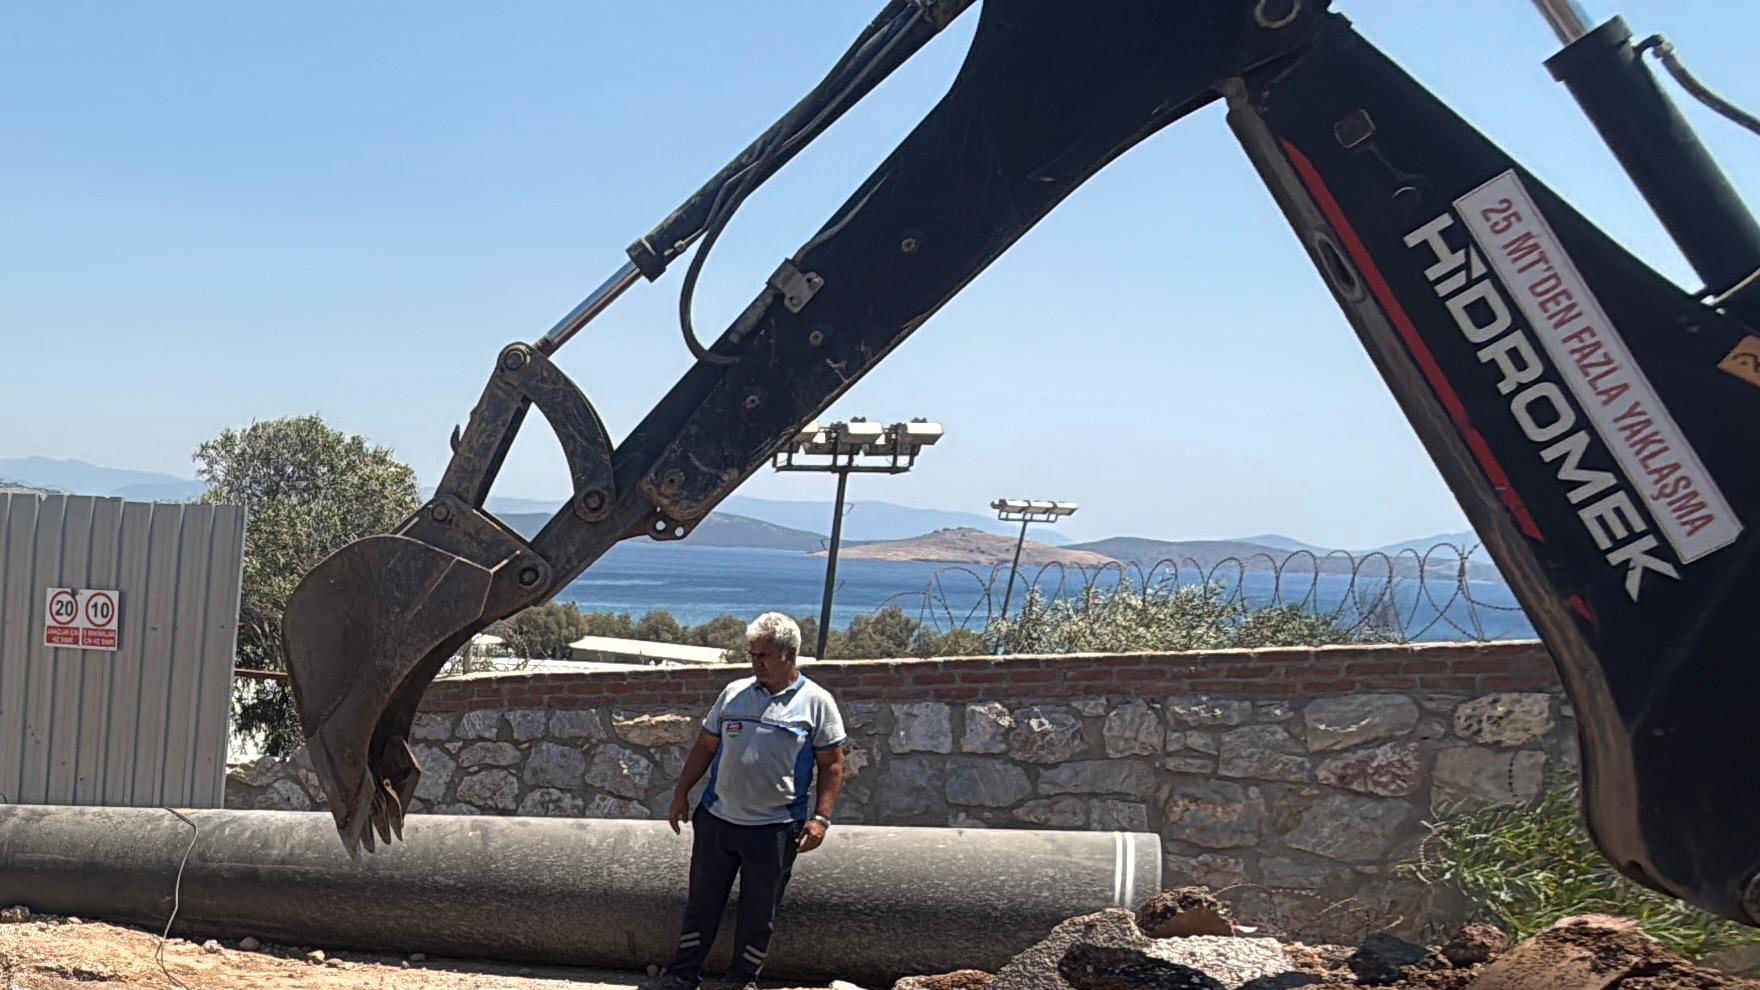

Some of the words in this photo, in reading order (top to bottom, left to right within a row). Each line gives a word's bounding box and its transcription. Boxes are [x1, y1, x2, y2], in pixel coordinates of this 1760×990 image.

[1480, 198, 1523, 235] 25
[1502, 231, 1584, 330] MT'DEN
[1561, 325, 1631, 406] FAZLA
[1612, 401, 1715, 537] YAKLAŞMA
[55, 600, 75, 617] 20
[91, 602, 110, 619] 10
